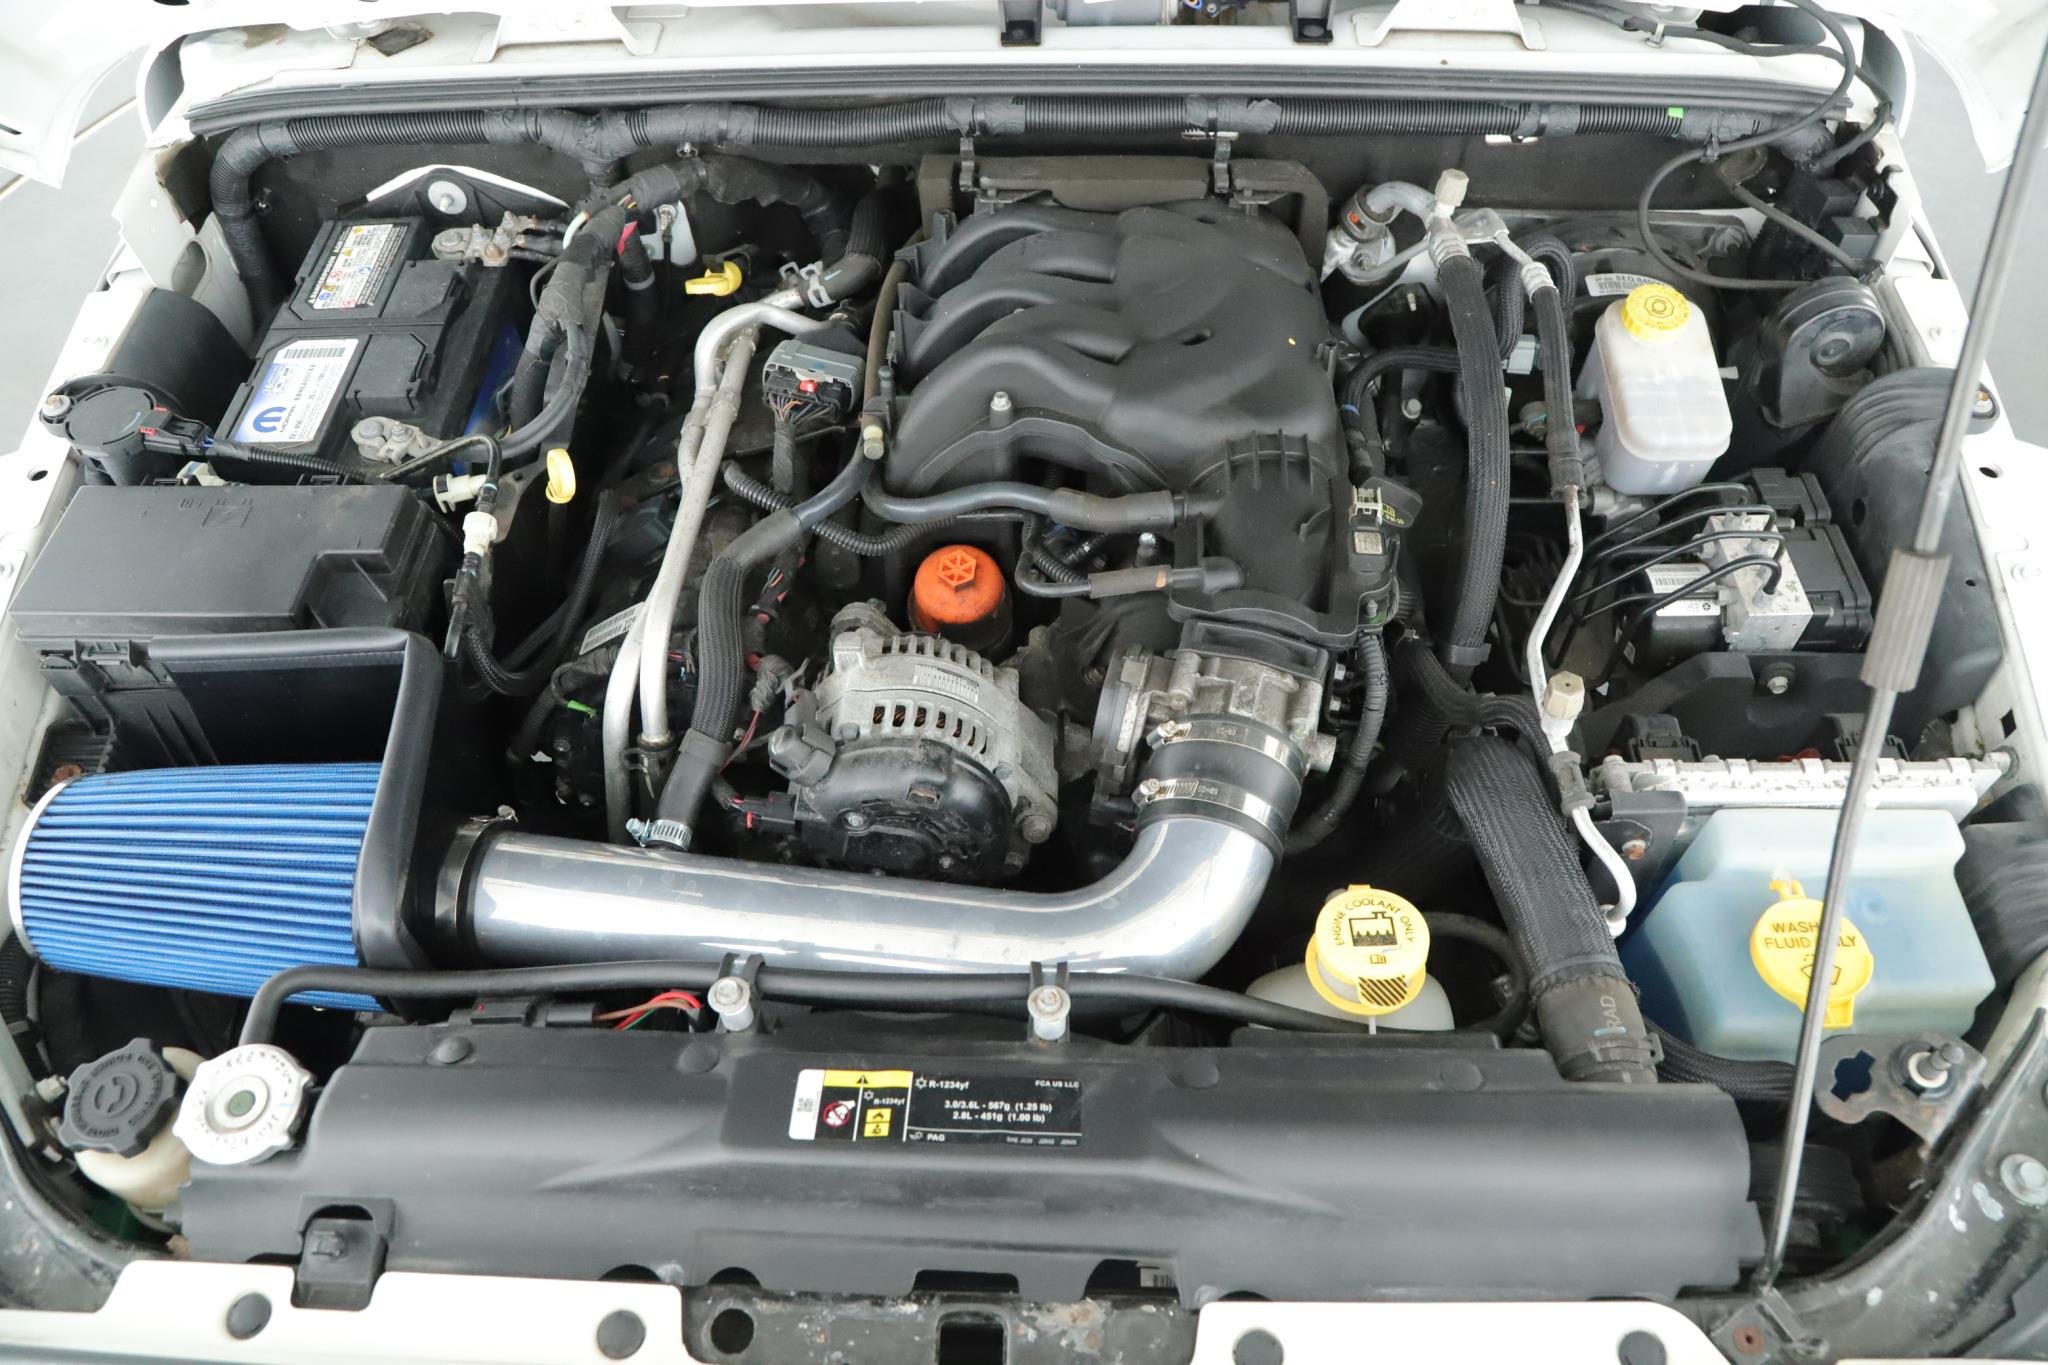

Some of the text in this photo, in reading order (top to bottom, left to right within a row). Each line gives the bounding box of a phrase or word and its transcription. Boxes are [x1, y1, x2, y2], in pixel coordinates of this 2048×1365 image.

[1330, 898, 1417, 946] ENGINE COOLANT ONLY
[1772, 921, 1841, 934] WASH
[1764, 936, 1811, 949] FLUID
[928, 1080, 969, 1090] R-1234yf
[1035, 1079, 1051, 1087] FCA
[944, 1100, 980, 1110] 3.0/3.6L
[987, 1100, 1011, 1111] 567g
[1014, 1100, 1038, 1112] (1.25
[1039, 1101, 1053, 1113] lb)
[952, 1111, 972, 1120] 2.8L
[979, 1111, 1003, 1122] 451g
[1007, 1112, 1031, 1122] (1.00
[1032, 1112, 1046, 1124] lb)
[926, 1133, 946, 1142] PAG
